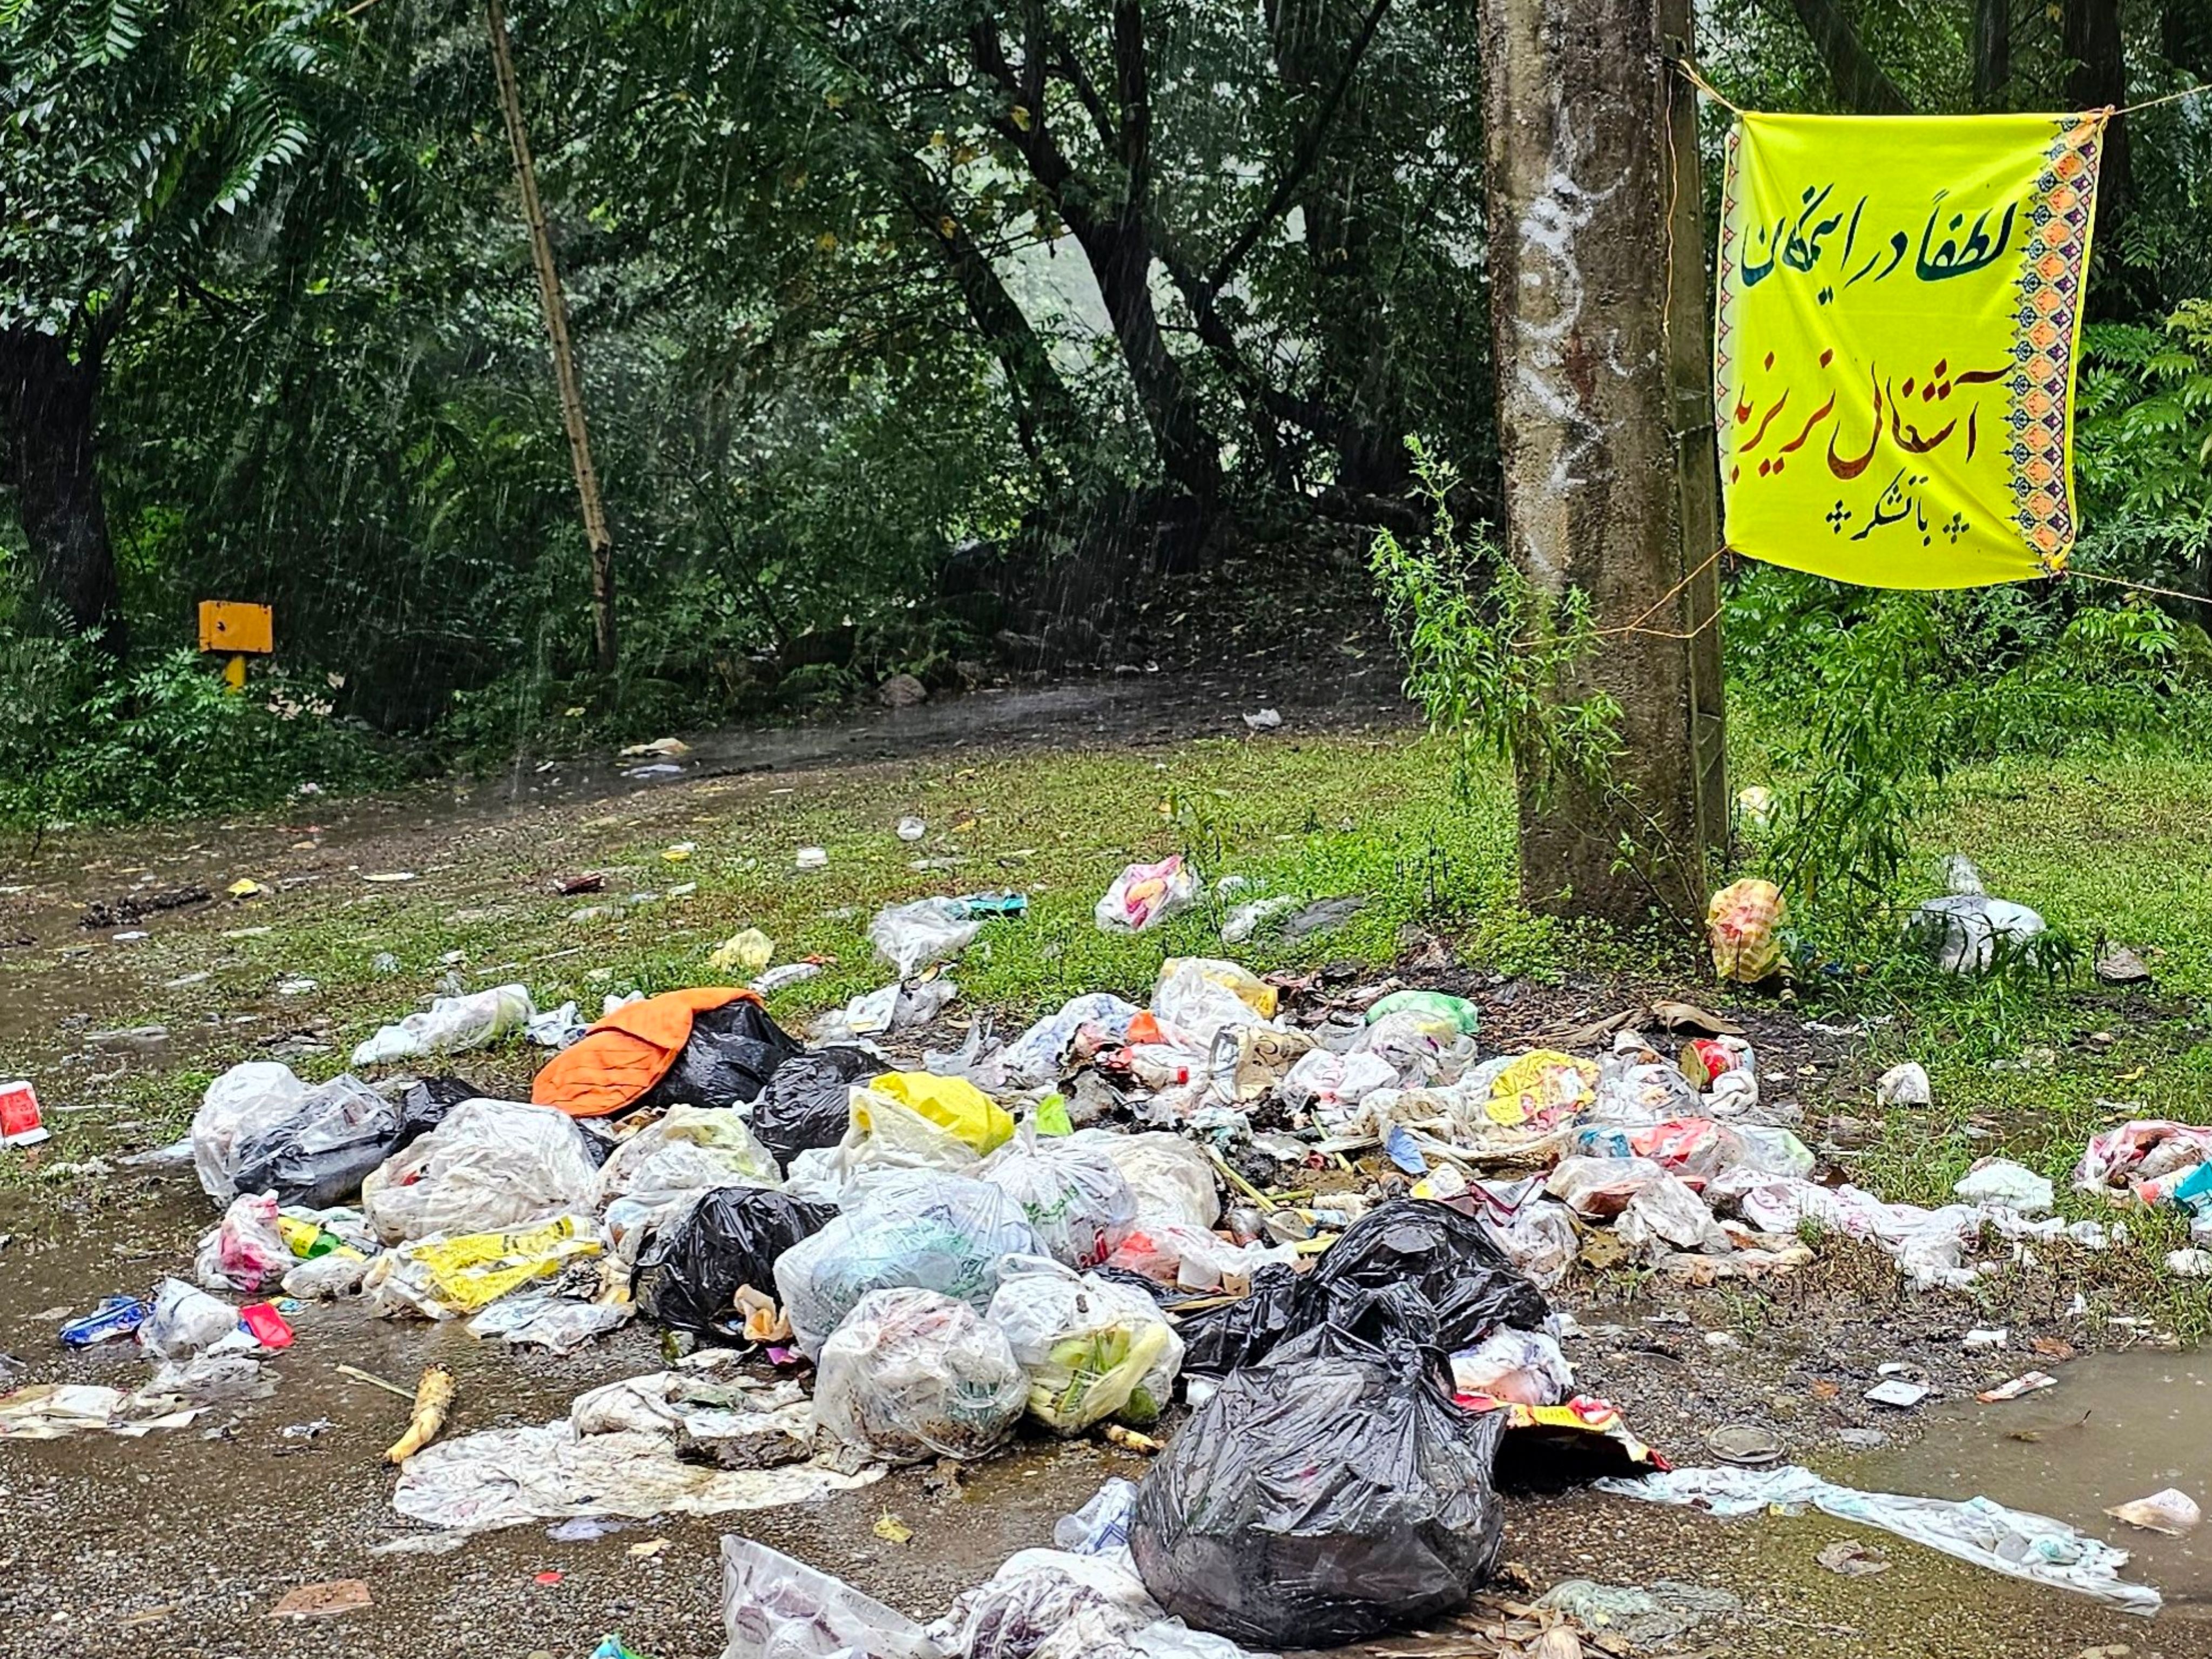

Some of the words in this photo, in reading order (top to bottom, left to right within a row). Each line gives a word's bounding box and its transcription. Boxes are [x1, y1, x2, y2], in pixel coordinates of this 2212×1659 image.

[1843, 231, 1908, 291] در
[1729, 348, 1836, 485] نریزید
[1827, 358, 2017, 480] آشغال
